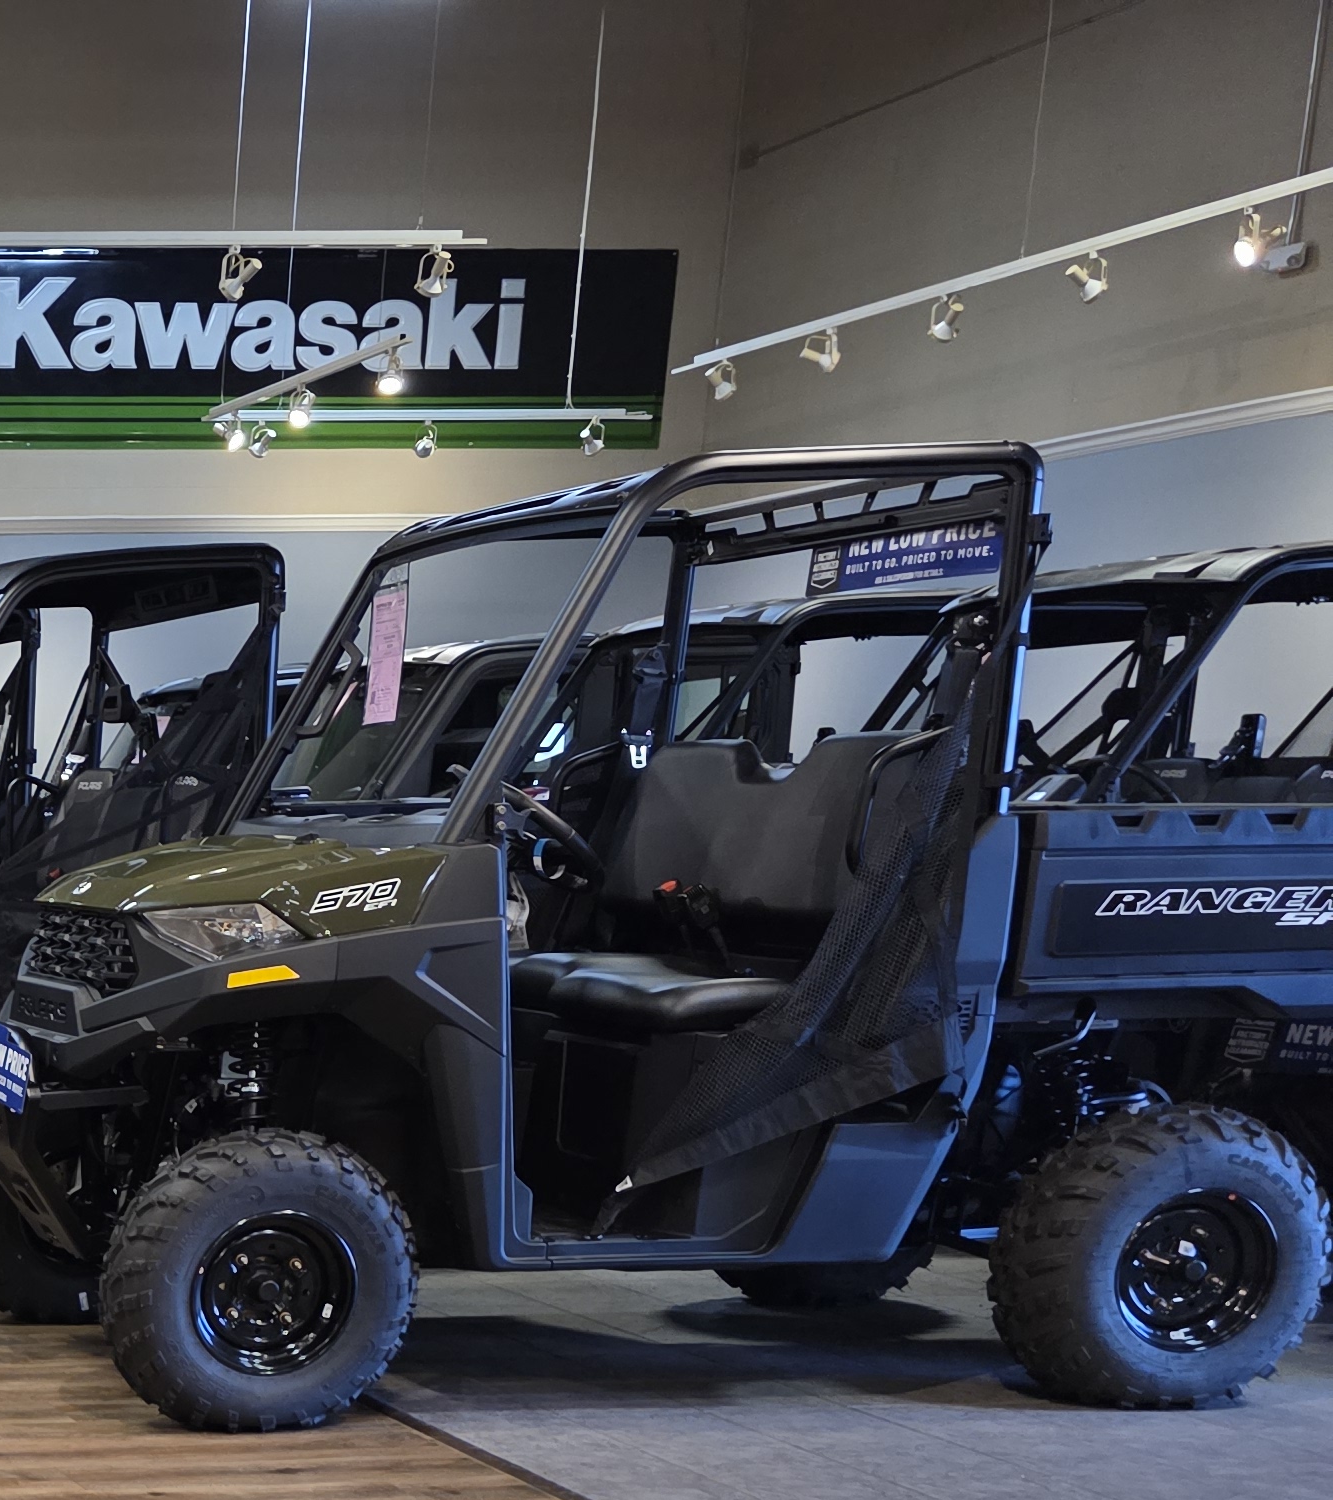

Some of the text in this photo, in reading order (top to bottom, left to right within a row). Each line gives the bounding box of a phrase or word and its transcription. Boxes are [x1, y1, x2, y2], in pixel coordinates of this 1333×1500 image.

[845, 562, 870, 575] BUILT
[872, 559, 882, 570] TO
[902, 551, 936, 566] PRICED
[940, 550, 954, 561] TO
[957, 545, 994, 559] MOVE.
[309, 878, 401, 914] 570
[1285, 1023, 1333, 1047] NEW
[5, 1047, 30, 1081] PRICE
[1279, 1049, 1312, 1060] BUILT
